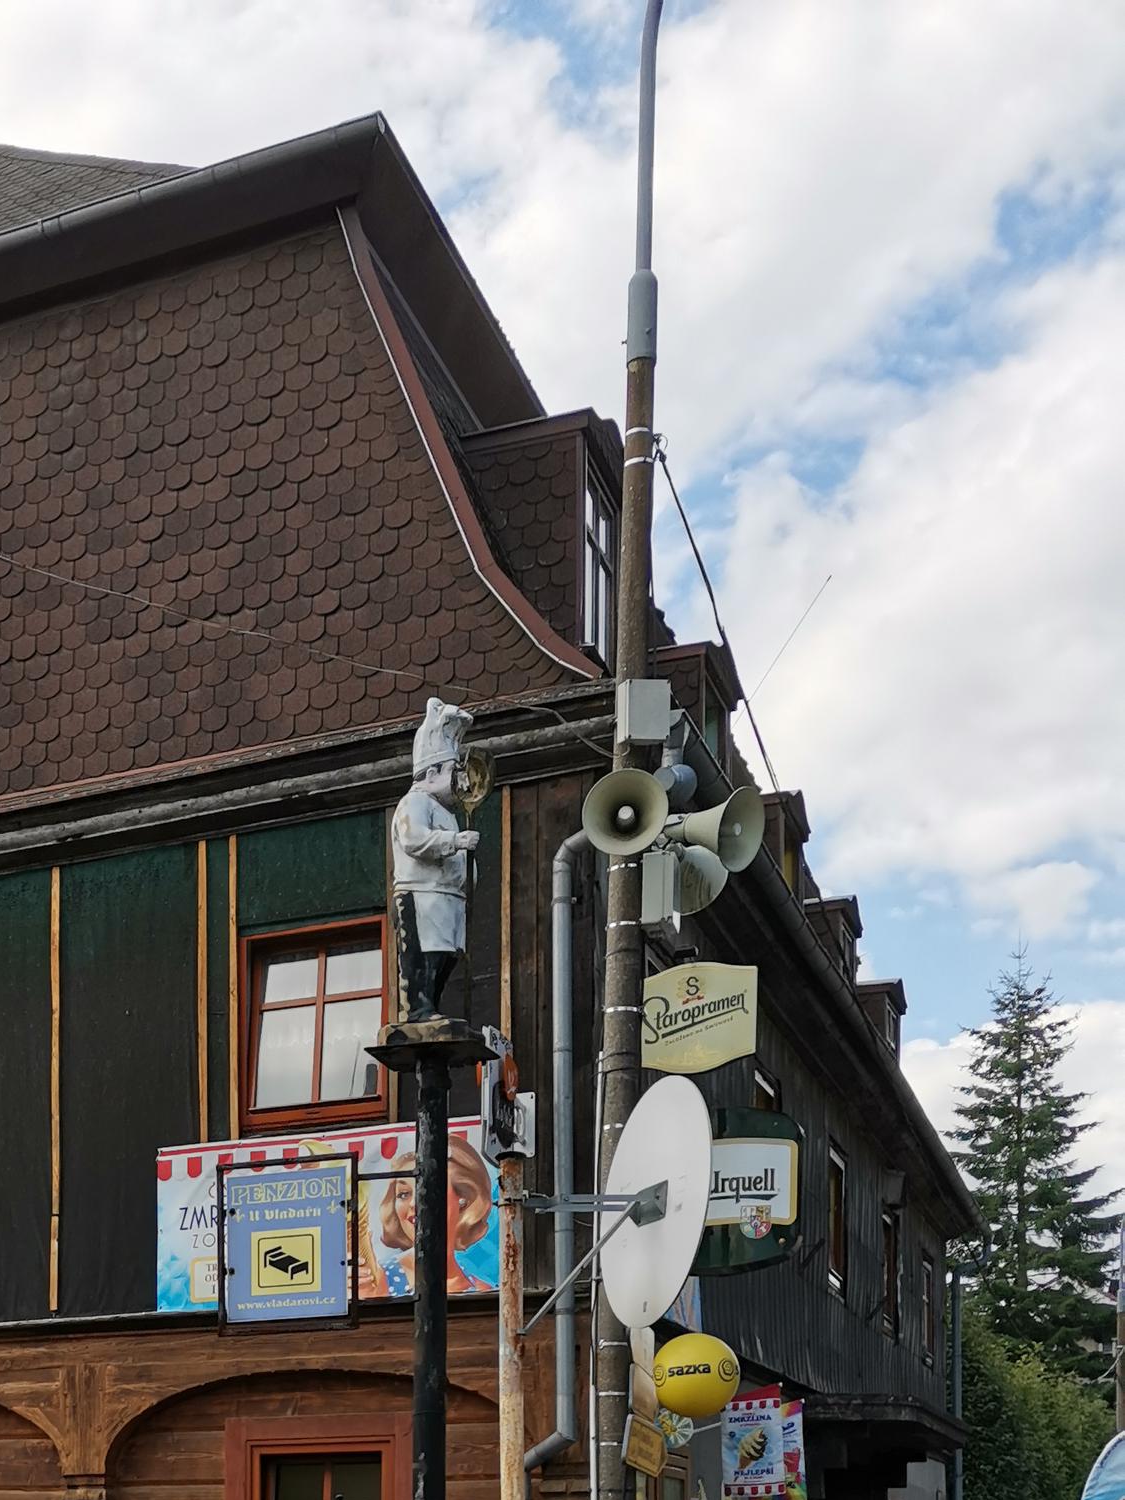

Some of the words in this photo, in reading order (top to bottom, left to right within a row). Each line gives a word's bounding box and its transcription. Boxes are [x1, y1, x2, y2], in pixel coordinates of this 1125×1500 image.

[642, 992, 750, 1045] Staropramen
[231, 1176, 342, 1206] PENZION
[668, 1363, 711, 1377] sazka
